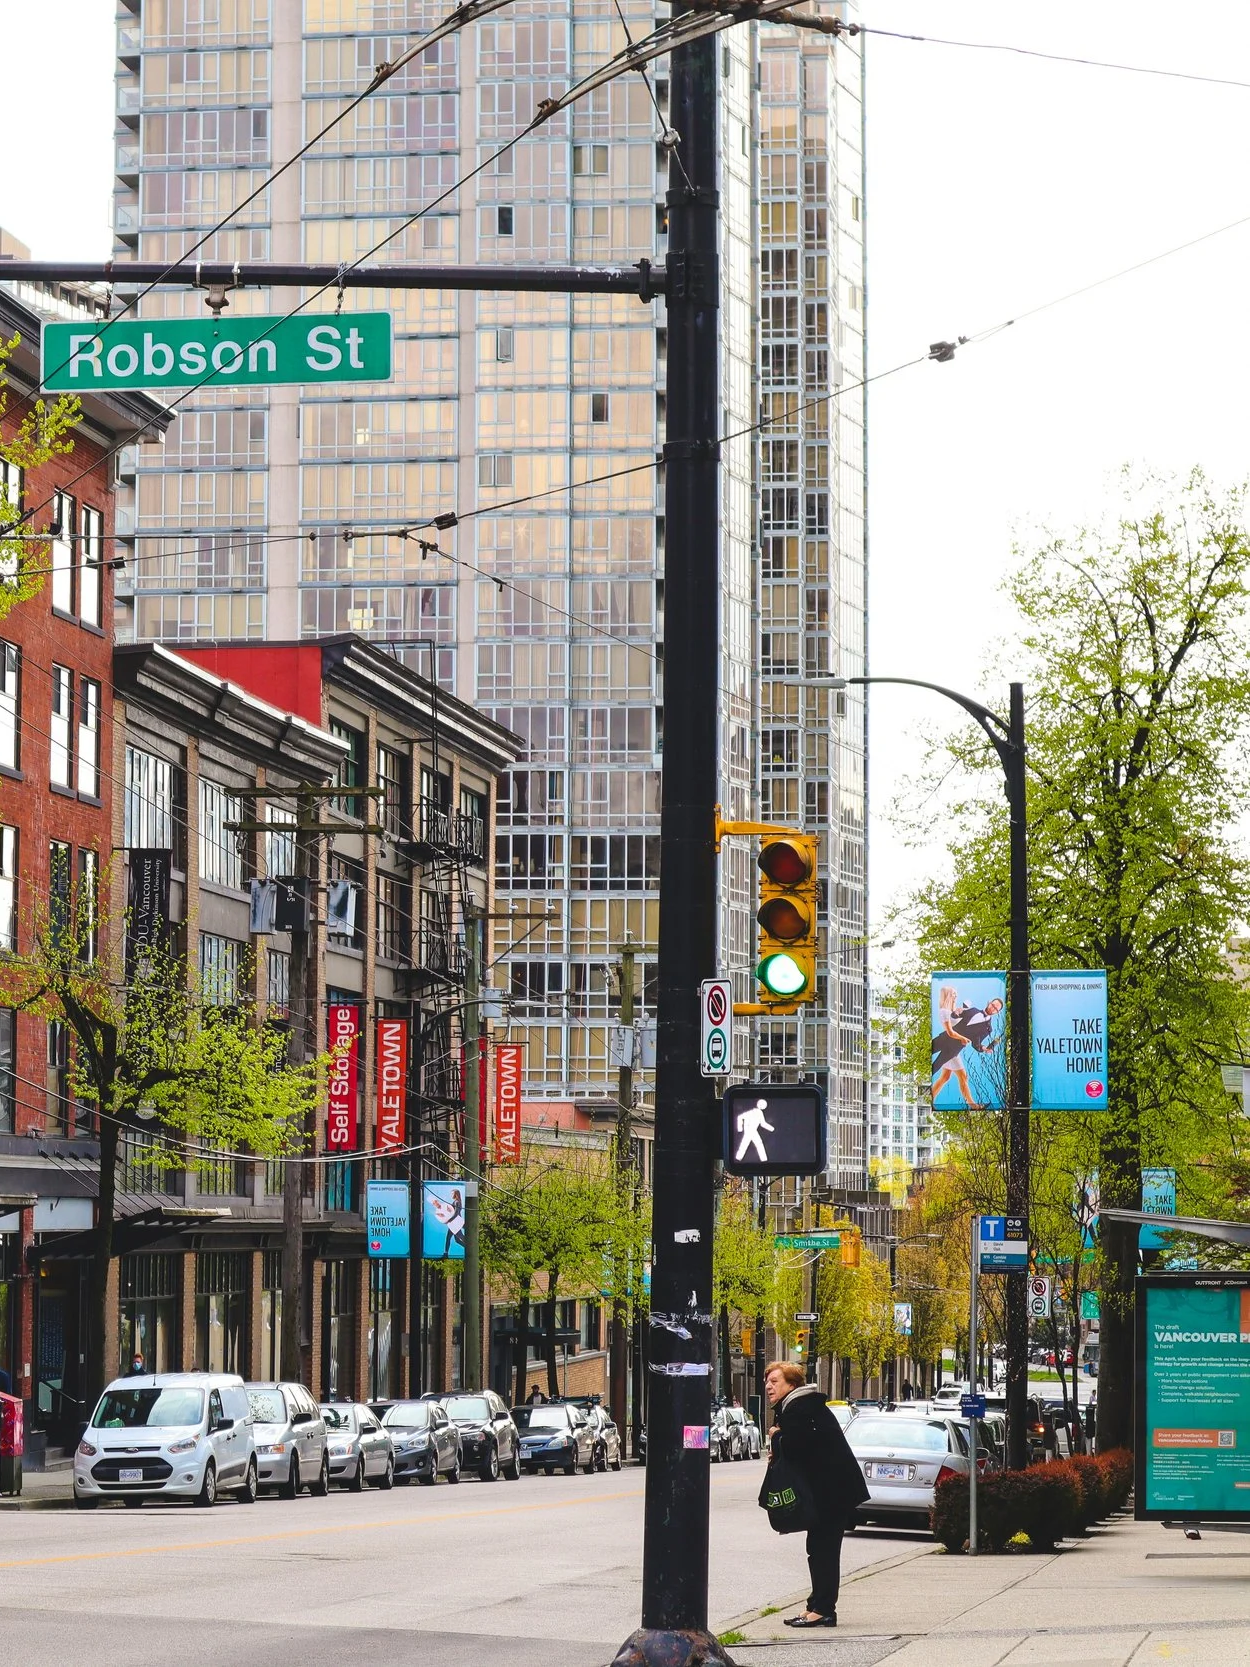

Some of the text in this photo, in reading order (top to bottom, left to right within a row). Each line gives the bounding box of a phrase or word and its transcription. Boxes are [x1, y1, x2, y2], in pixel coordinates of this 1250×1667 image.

[69, 325, 365, 378] Robson St
[153, 859, 162, 891] University
[1072, 1018, 1102, 1034] TAKE
[1036, 1038, 1102, 1053] YALETOWN
[1066, 1057, 1102, 1073] HOME
[331, 1008, 355, 1143] Self Storage
[381, 1023, 401, 1152] YALETOWN
[500, 1048, 517, 1161] YALETOWN
[1155, 1195, 1172, 1205] TAKE
[985, 1220, 999, 1237] T
[794, 1238, 820, 1247] Smithe
[1154, 1332, 1237, 1343] VANCOUVER
